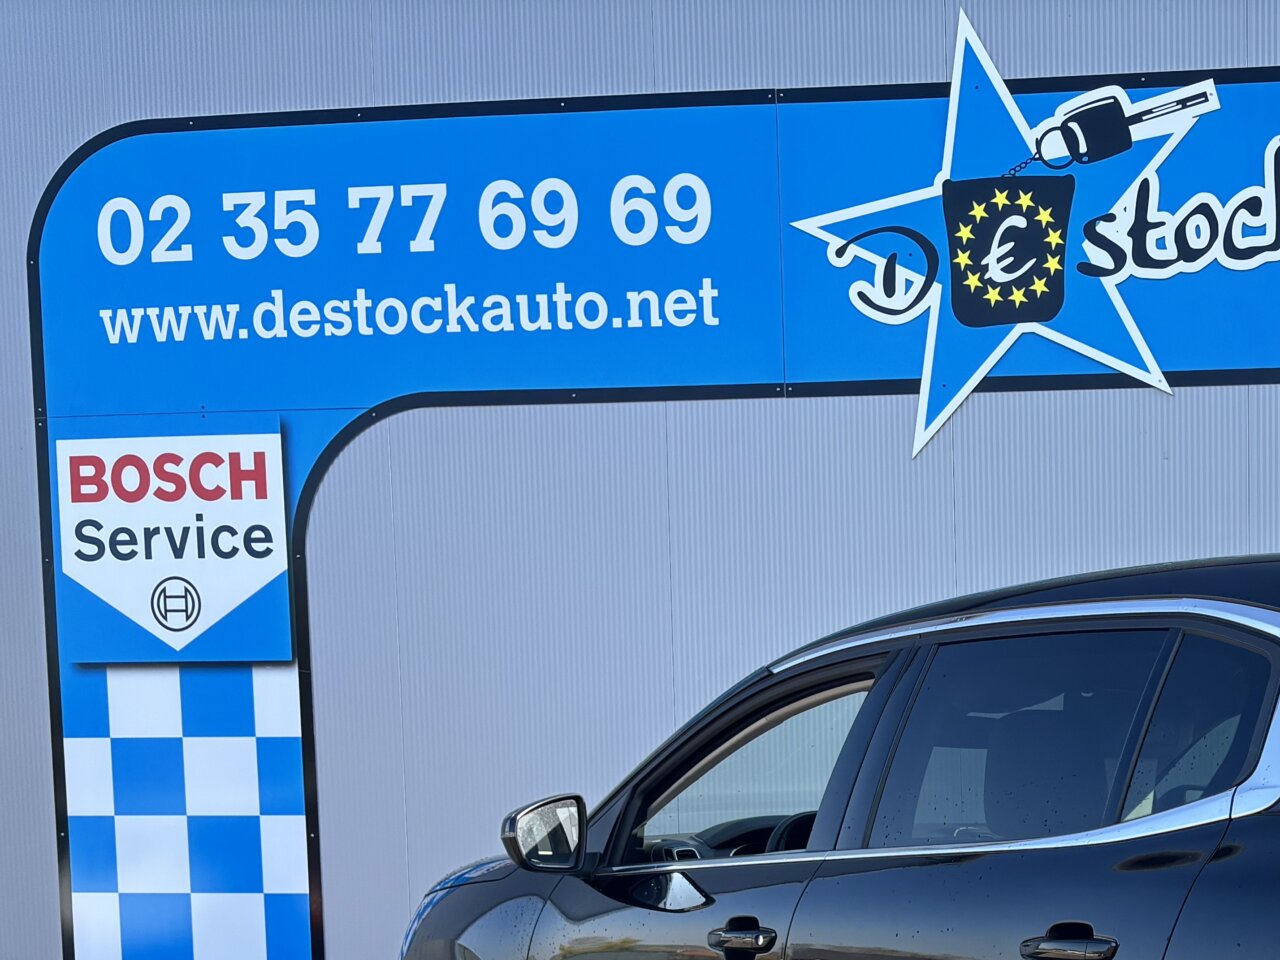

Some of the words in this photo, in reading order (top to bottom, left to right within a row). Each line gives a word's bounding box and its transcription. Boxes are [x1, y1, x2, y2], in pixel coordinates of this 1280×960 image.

[97, 194, 193, 266] 02
[222, 189, 320, 260] 35
[347, 183, 447, 254] 77
[478, 177, 579, 250] 69
[610, 172, 712, 246] 69
[99, 277, 720, 344] www.destockauto.net
[68, 451, 268, 503] BOSCH
[74, 513, 274, 562] Service
